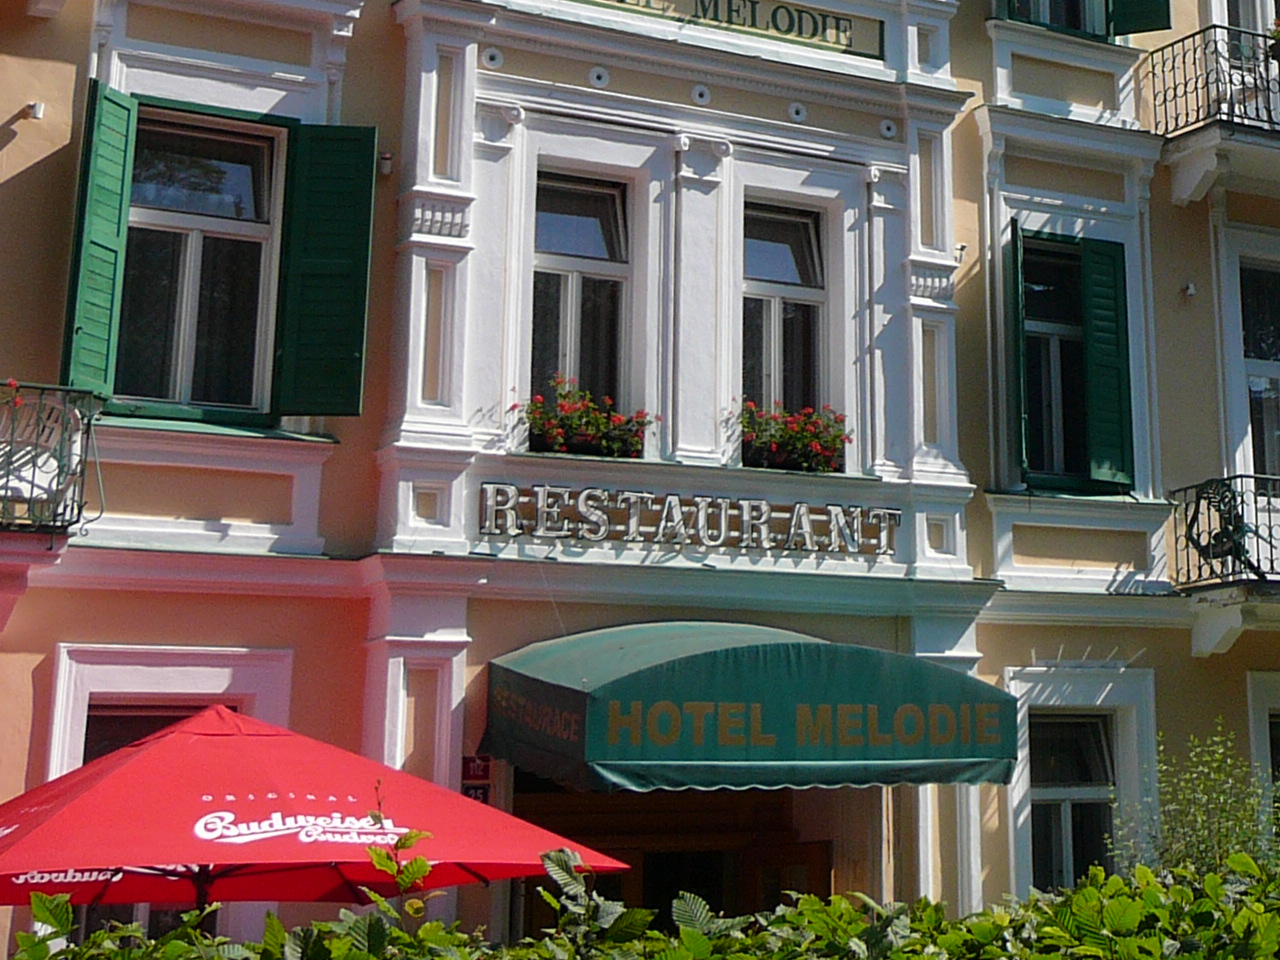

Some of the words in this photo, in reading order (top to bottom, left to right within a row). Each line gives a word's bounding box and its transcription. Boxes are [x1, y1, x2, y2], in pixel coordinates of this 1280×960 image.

[480, 482, 902, 556] RESTAURANT
[606, 700, 777, 747] HOTEL
[795, 702, 1001, 747] MELODIE
[202, 792, 357, 802] ORIGINAL
[194, 811, 410, 843] Budweiser
